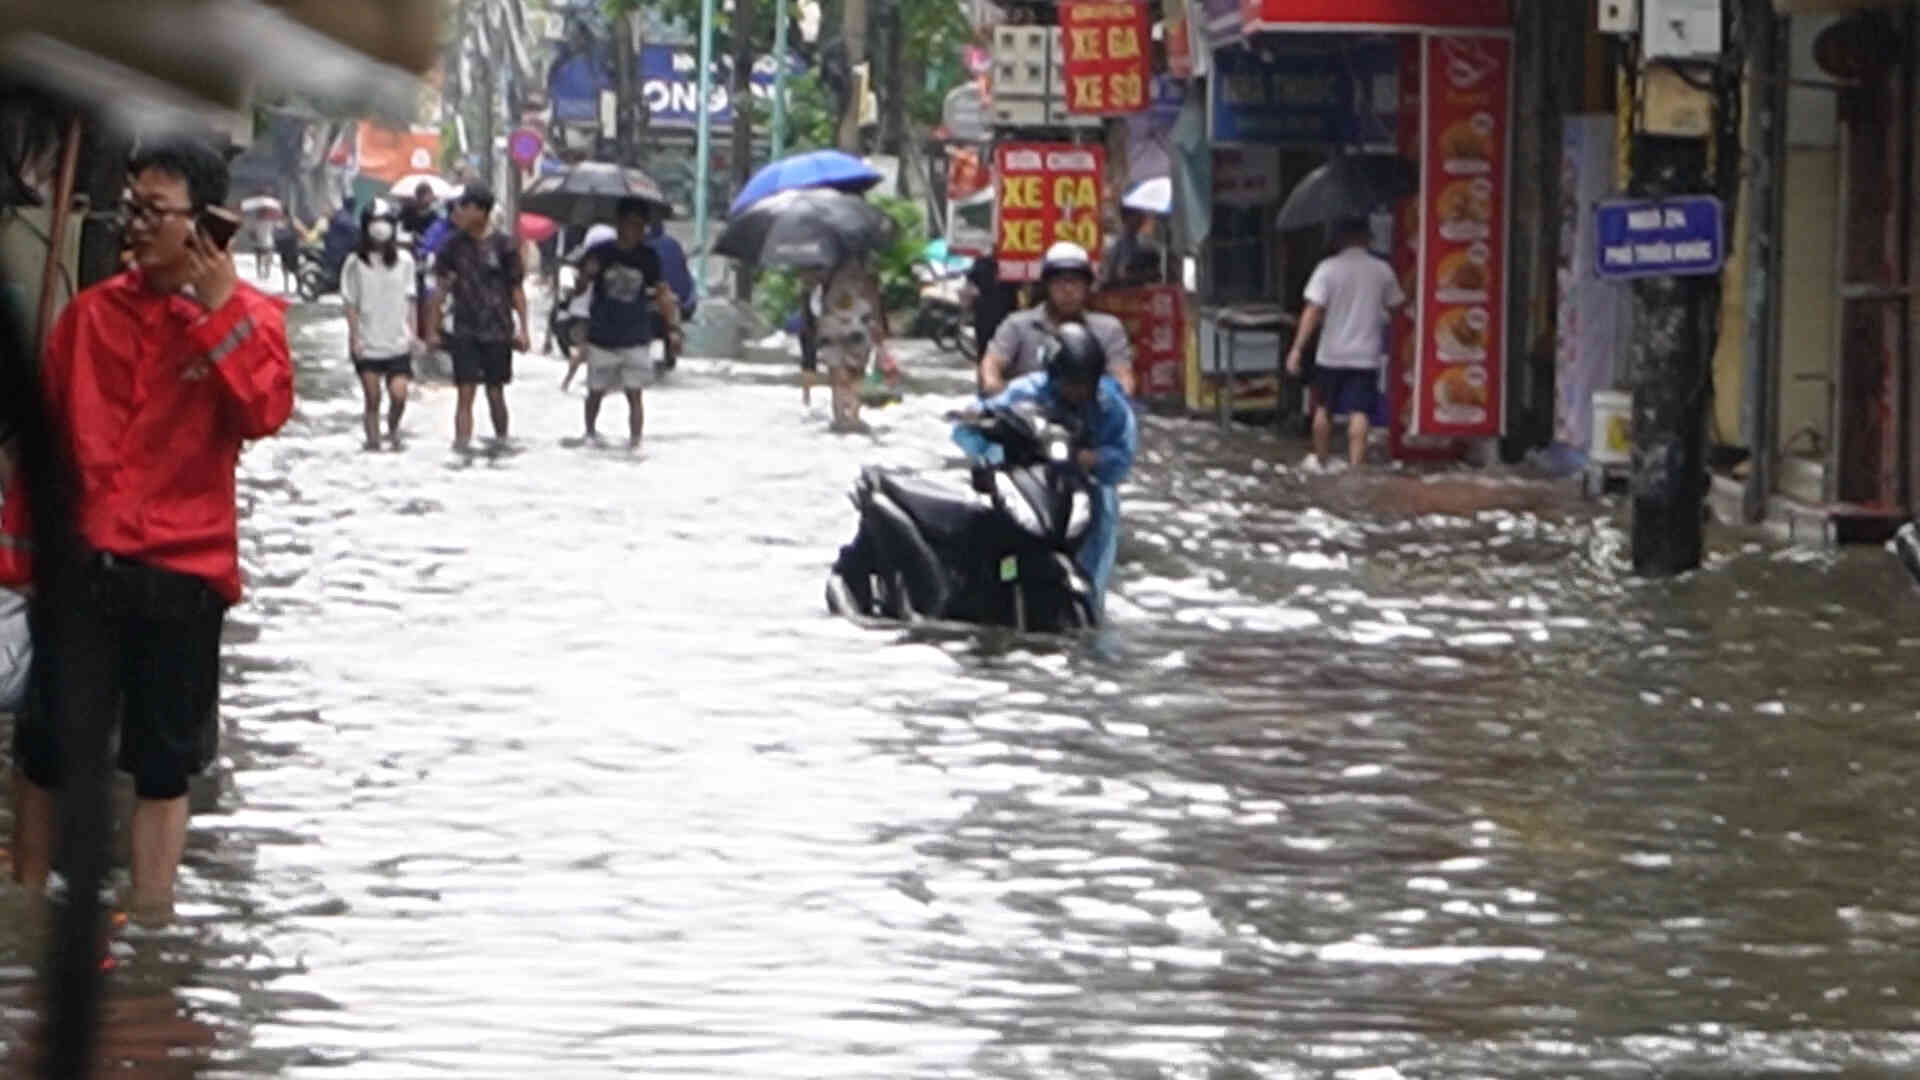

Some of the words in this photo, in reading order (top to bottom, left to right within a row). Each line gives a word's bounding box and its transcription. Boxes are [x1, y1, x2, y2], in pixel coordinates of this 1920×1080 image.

[1070, 27, 1101, 59] XE
[1107, 27, 1141, 59] GA
[1072, 74, 1103, 106] XE
[1002, 176, 1043, 208] XE
[1053, 176, 1096, 208] GA
[1002, 220, 1043, 252] XE
